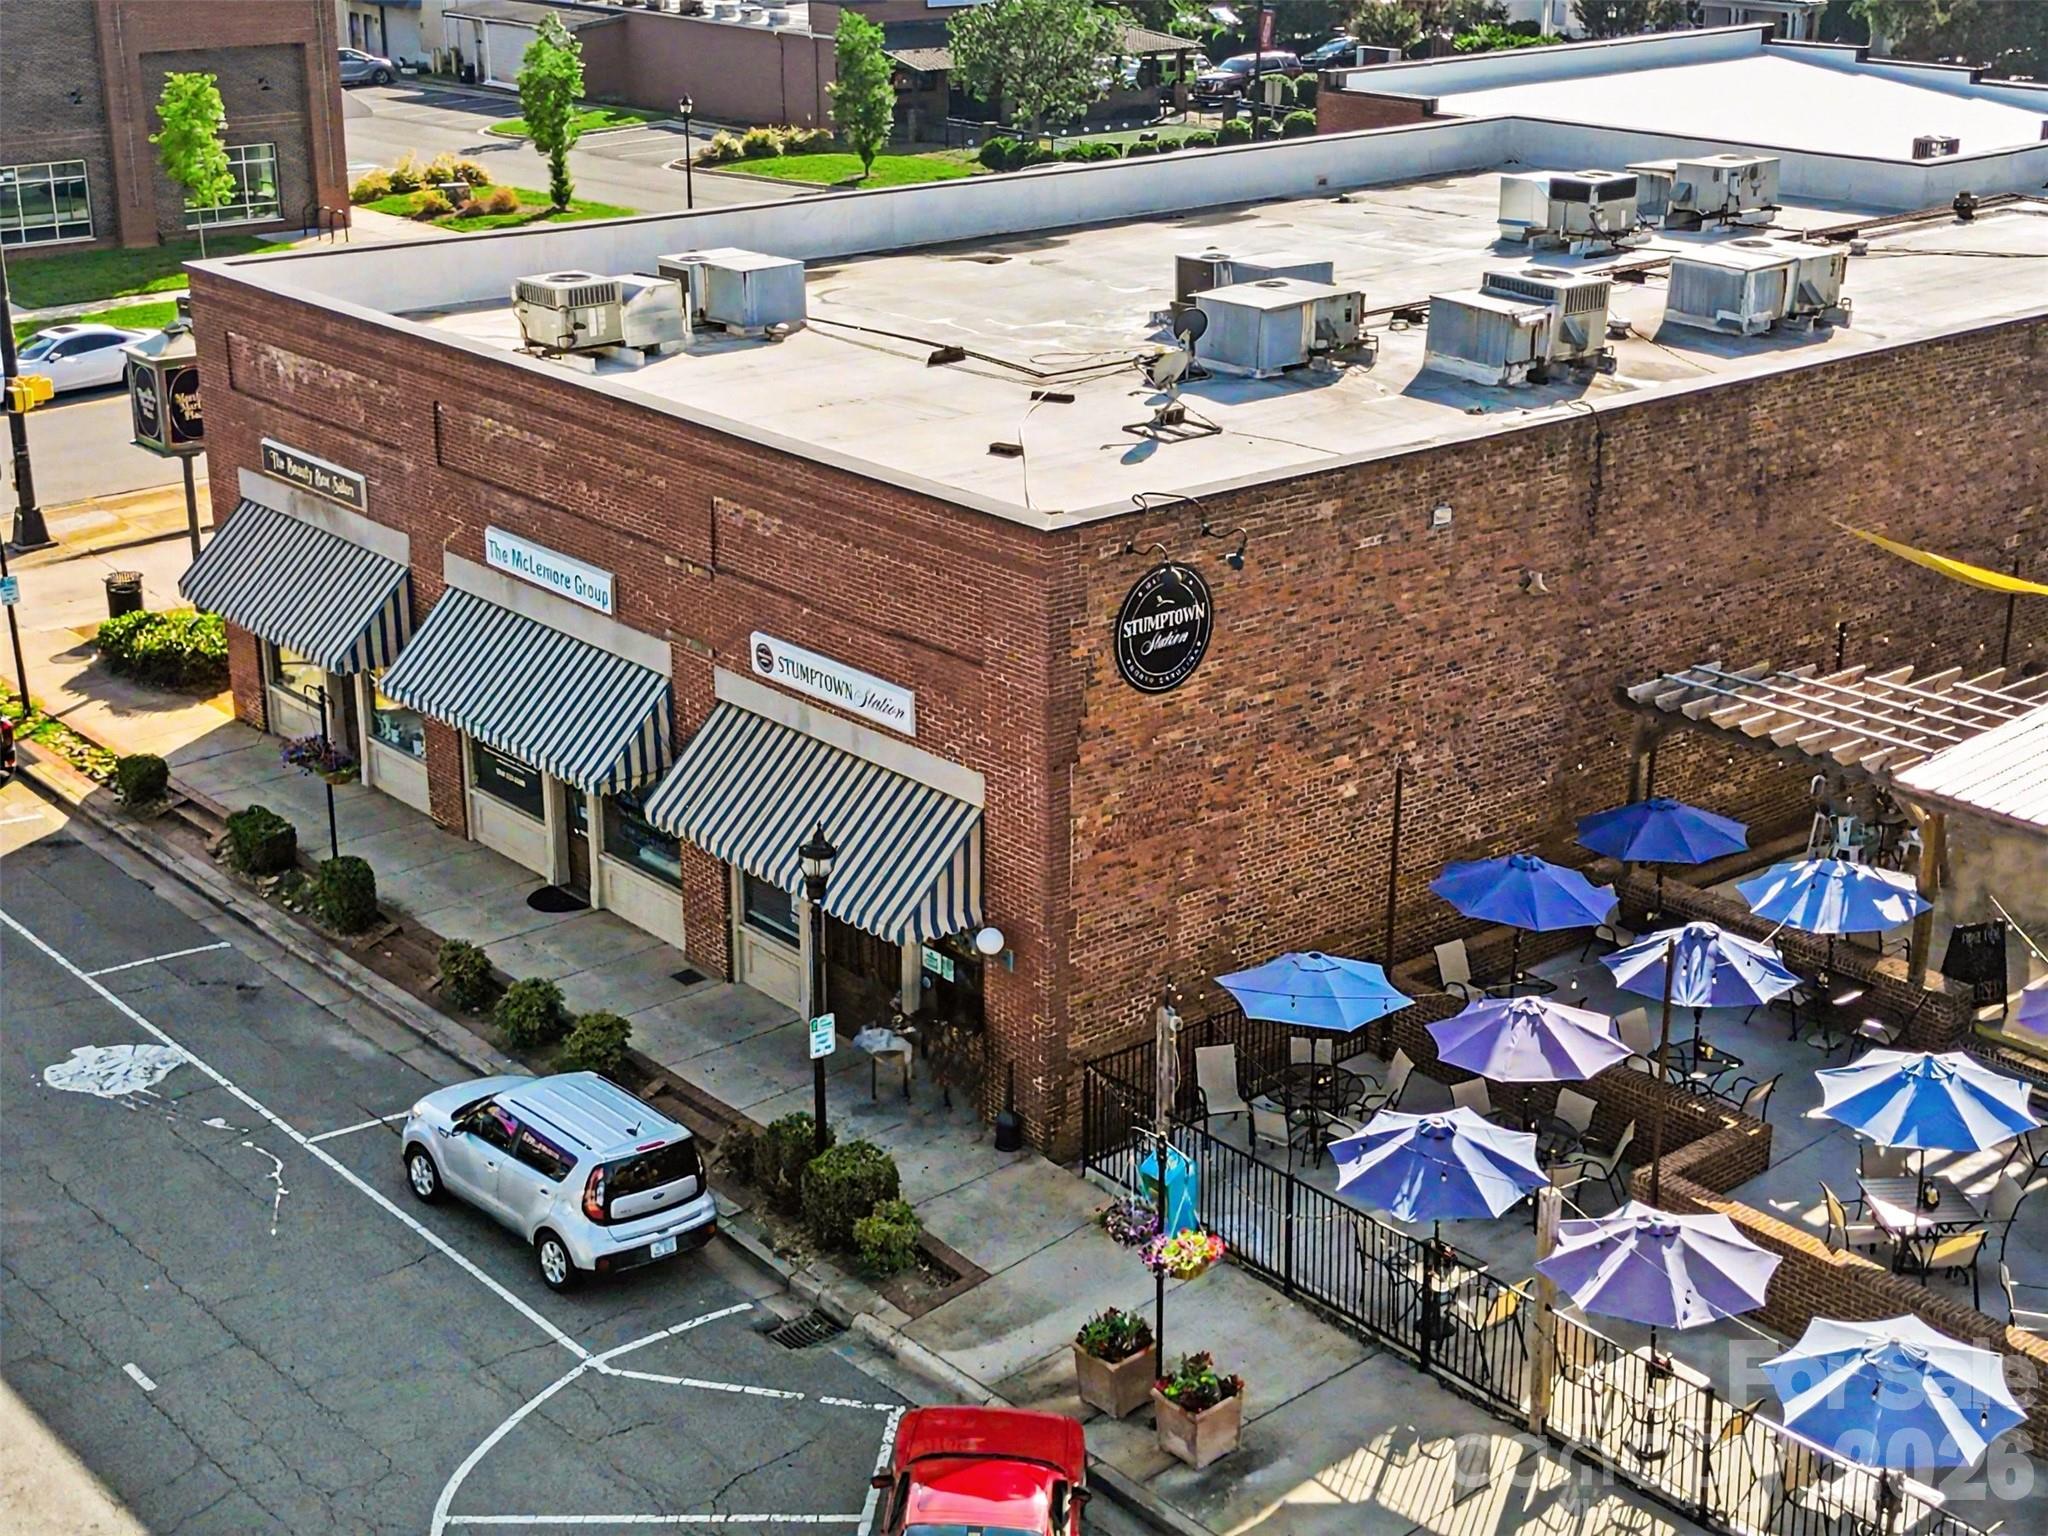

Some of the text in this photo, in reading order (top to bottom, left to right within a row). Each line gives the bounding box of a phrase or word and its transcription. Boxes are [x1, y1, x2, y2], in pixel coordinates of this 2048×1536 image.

[268, 450, 285, 470] The
[286, 457, 313, 485] Beauty
[331, 475, 355, 498] Salon
[487, 539, 609, 610] The McLemore Group
[1123, 602, 1205, 639] STUMPTOWN
[1140, 629, 1189, 656] Station
[778, 655, 853, 701] STUMPTOWN
[854, 687, 905, 720] Station
